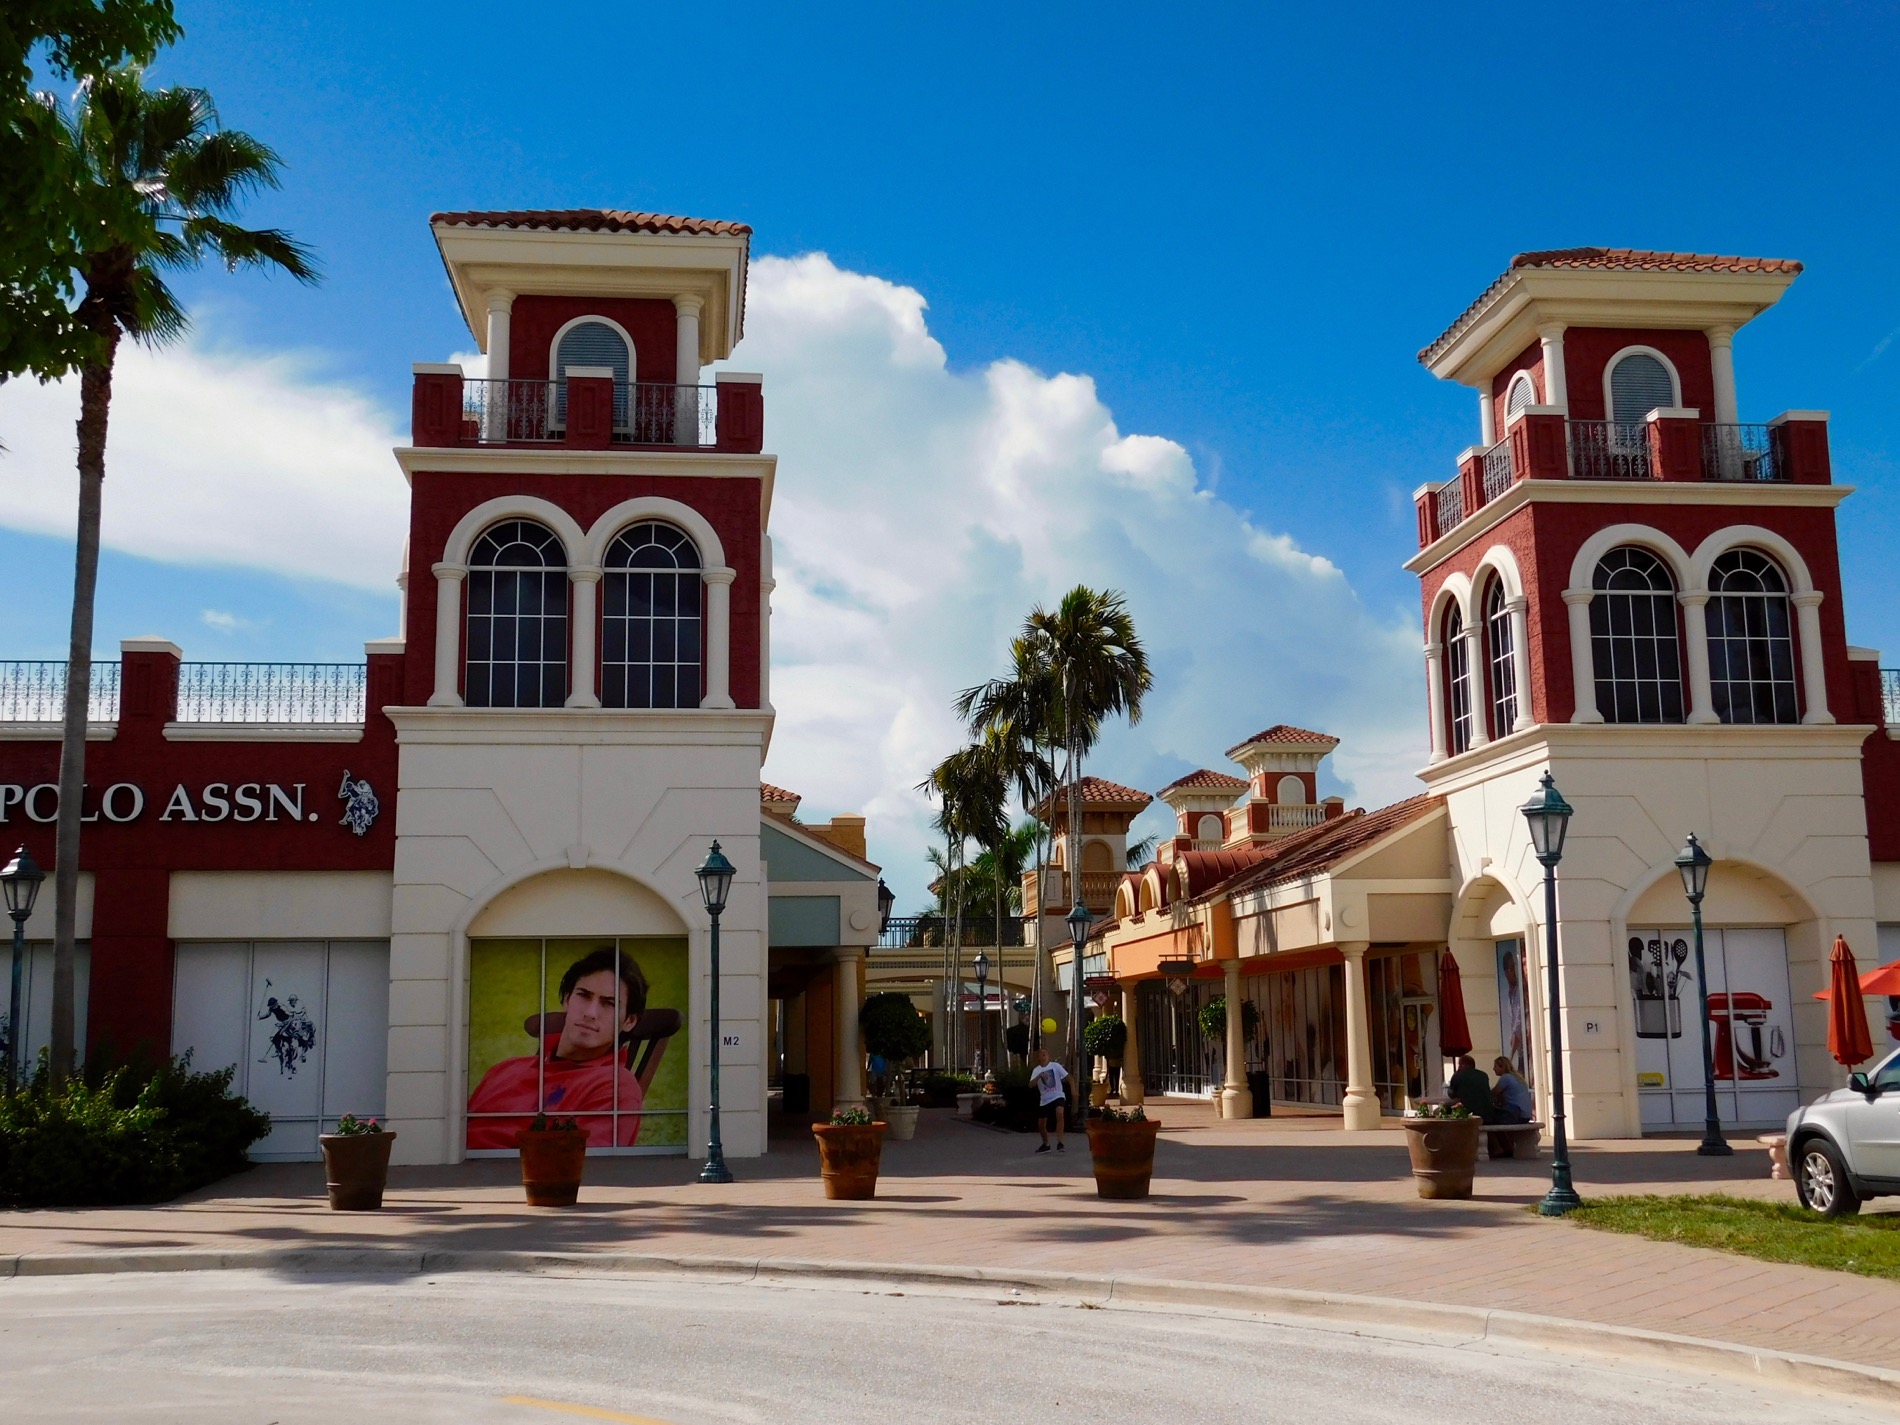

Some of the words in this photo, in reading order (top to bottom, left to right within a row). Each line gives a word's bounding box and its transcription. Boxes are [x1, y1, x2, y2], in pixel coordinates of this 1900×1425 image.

[159, 783, 319, 822] ASSN.
[1586, 1022, 1599, 1033] P1
[723, 1034, 740, 1046] M2
